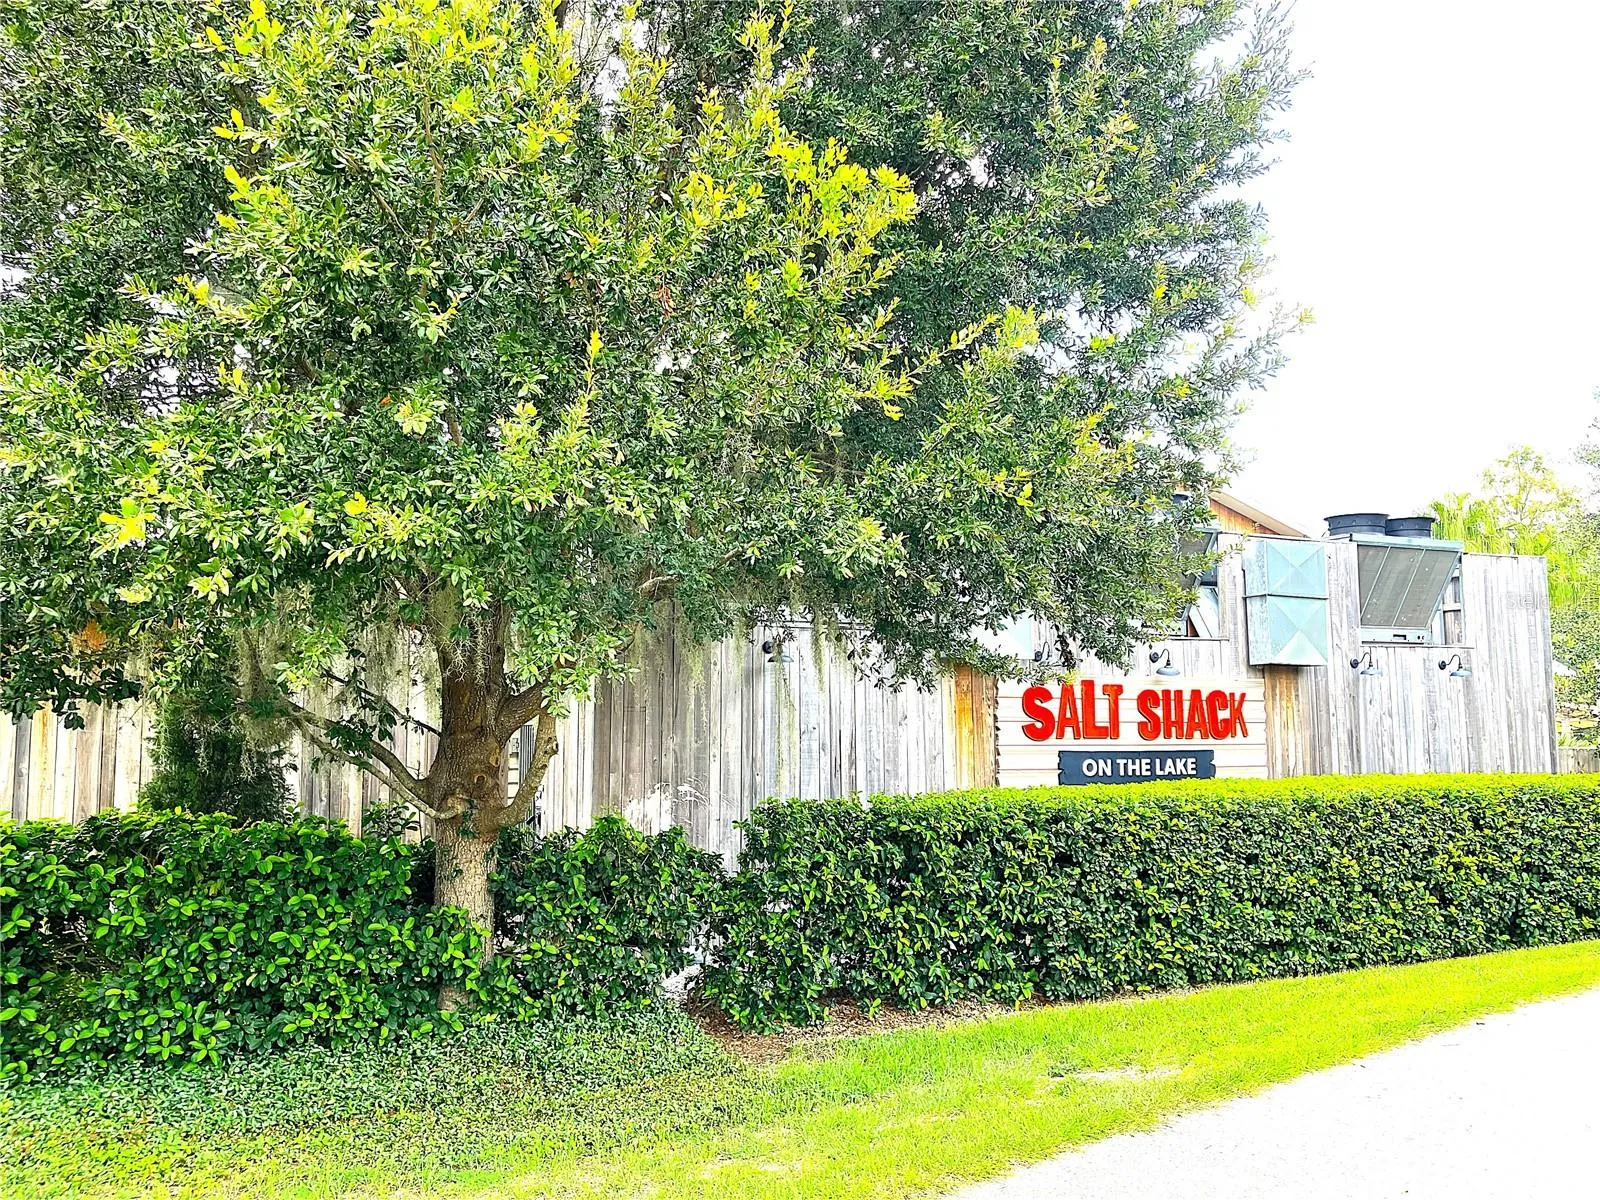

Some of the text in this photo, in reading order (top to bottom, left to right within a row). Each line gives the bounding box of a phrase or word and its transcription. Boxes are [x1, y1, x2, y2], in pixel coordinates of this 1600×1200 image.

[1021, 680, 1249, 742] SALT SHACK
[1082, 757, 1197, 777] ON THE LAKE
